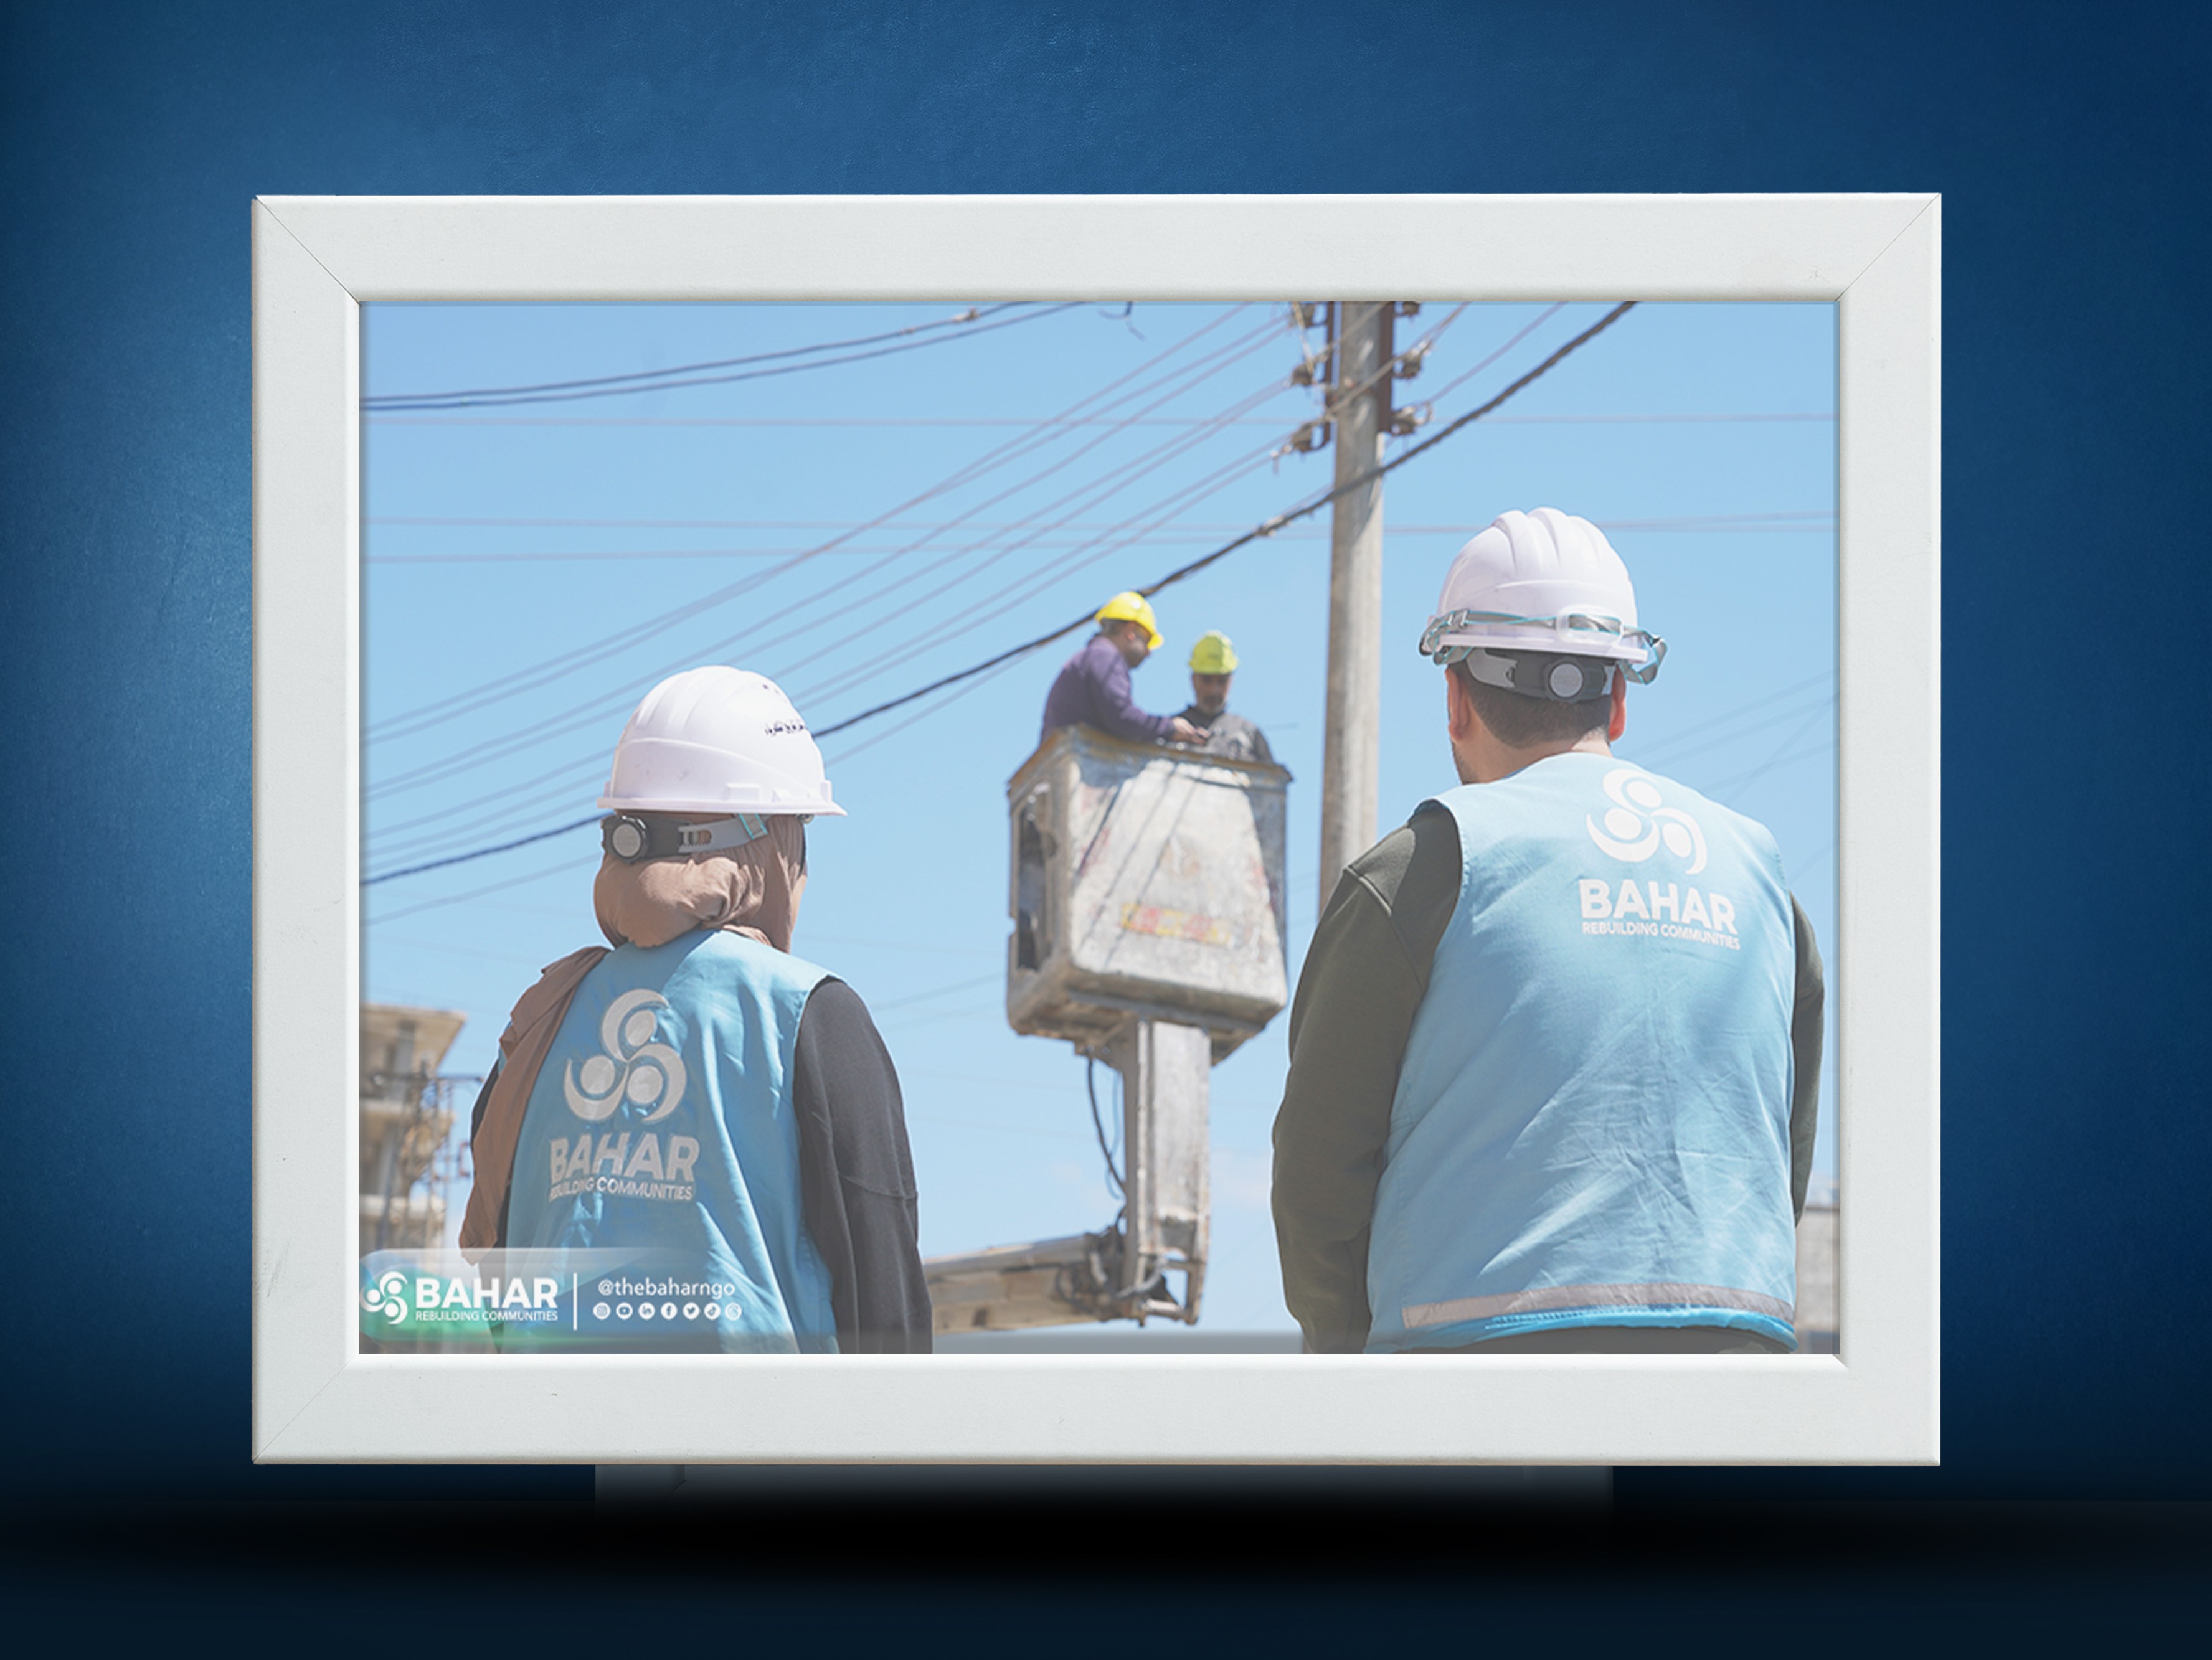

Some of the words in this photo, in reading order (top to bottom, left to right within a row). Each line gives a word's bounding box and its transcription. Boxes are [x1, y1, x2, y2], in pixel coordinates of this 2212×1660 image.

[1579, 879, 1738, 935] BAHAR
[1582, 922, 1658, 936] REBUILDING
[1661, 924, 1741, 950] COMMUNITIES
[550, 1132, 699, 1185] BAHAR
[596, 1176, 692, 1200] COMMUNITIES
